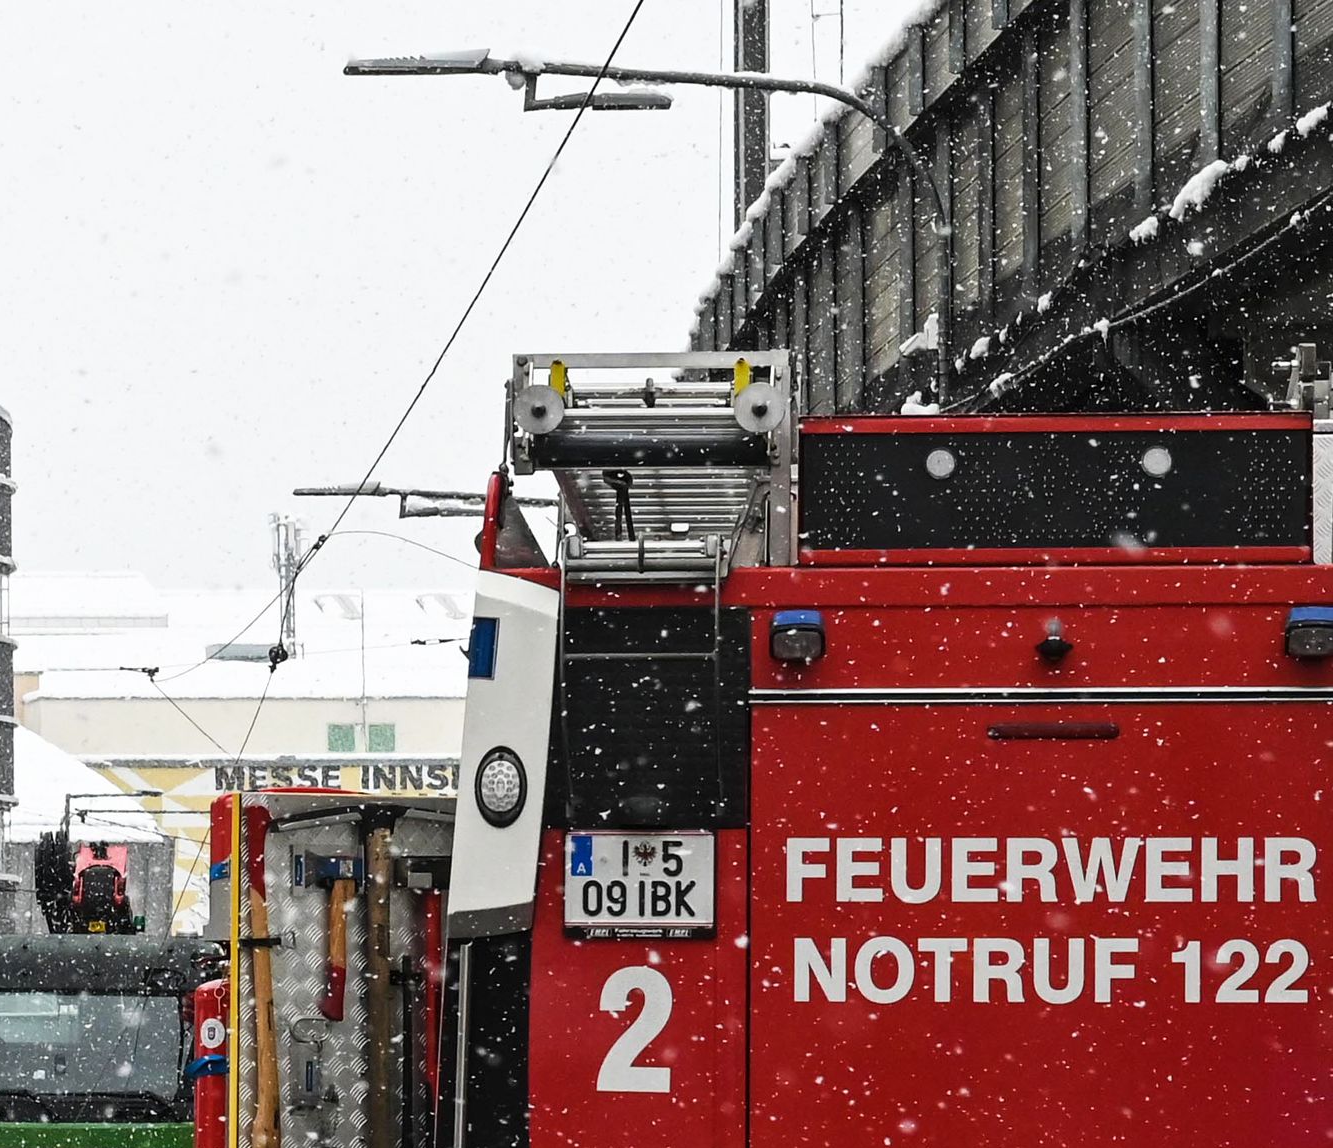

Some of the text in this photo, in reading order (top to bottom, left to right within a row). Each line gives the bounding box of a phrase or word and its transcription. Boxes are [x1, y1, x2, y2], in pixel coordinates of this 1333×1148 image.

[215, 765, 341, 791] MESSE
[576, 863, 587, 874] A
[622, 840, 683, 877] I 5
[786, 837, 1317, 903] FEUERWEHR
[582, 880, 696, 918] 09 IBK
[794, 936, 1310, 1004] NOTRUF 122
[596, 966, 673, 1093] 2
